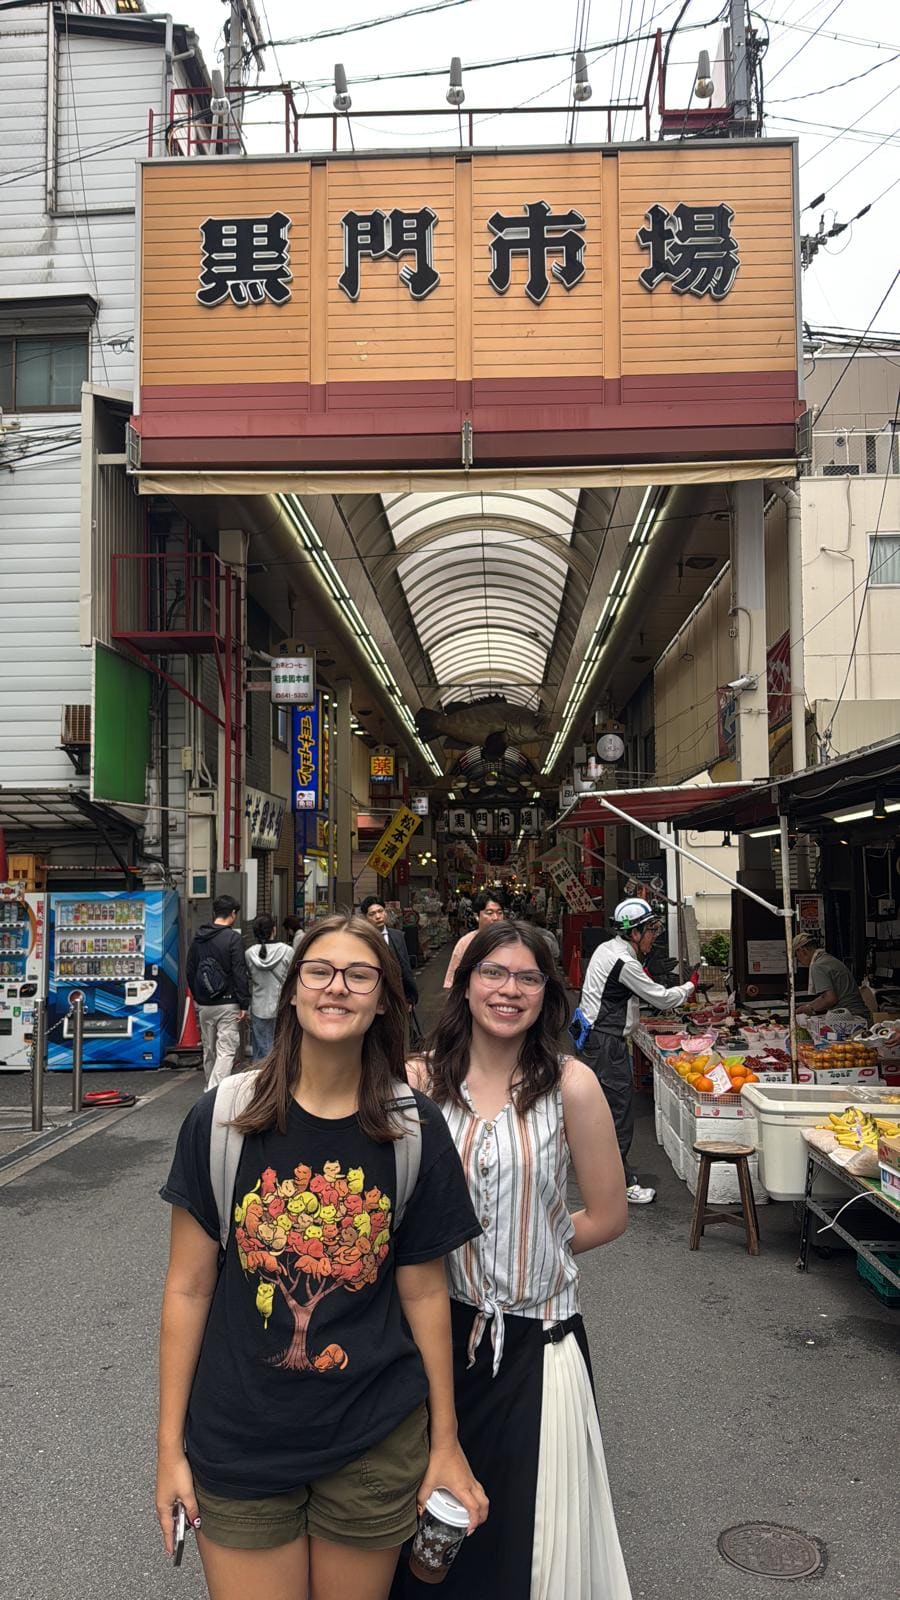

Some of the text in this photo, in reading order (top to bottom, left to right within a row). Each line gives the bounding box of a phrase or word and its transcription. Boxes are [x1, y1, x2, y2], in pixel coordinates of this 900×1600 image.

[197, 201, 742, 308] 黒門市場
[297, 715, 315, 786] マツモトキヨシ
[373, 757, 391, 774] 薬
[382, 814, 414, 859] 松本清
